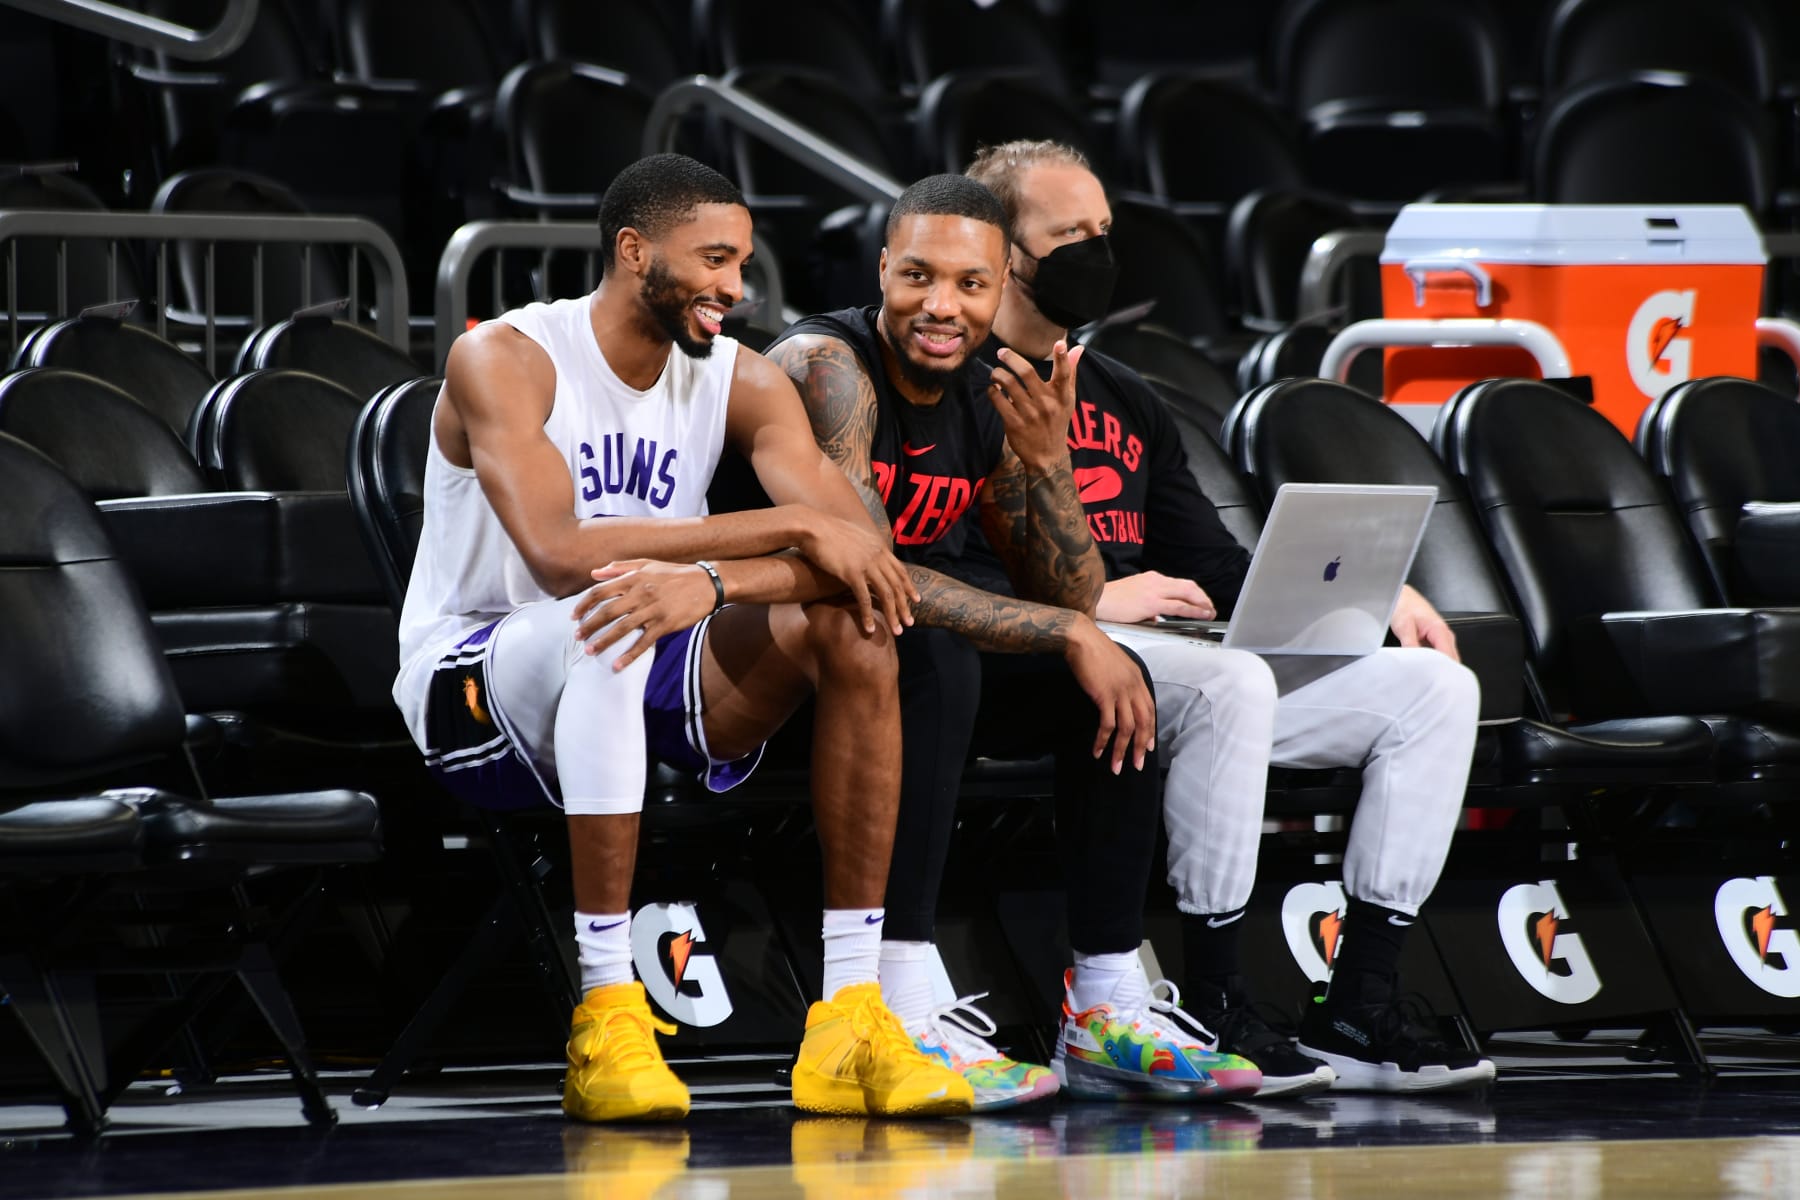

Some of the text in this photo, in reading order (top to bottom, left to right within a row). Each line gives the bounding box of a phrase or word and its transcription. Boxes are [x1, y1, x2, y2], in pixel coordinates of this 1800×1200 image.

[1626, 290, 1696, 400] G
[580, 433, 677, 509] SUNS
[631, 902, 734, 1027] G
[1498, 879, 1602, 1004] G
[1715, 876, 1800, 998] G
